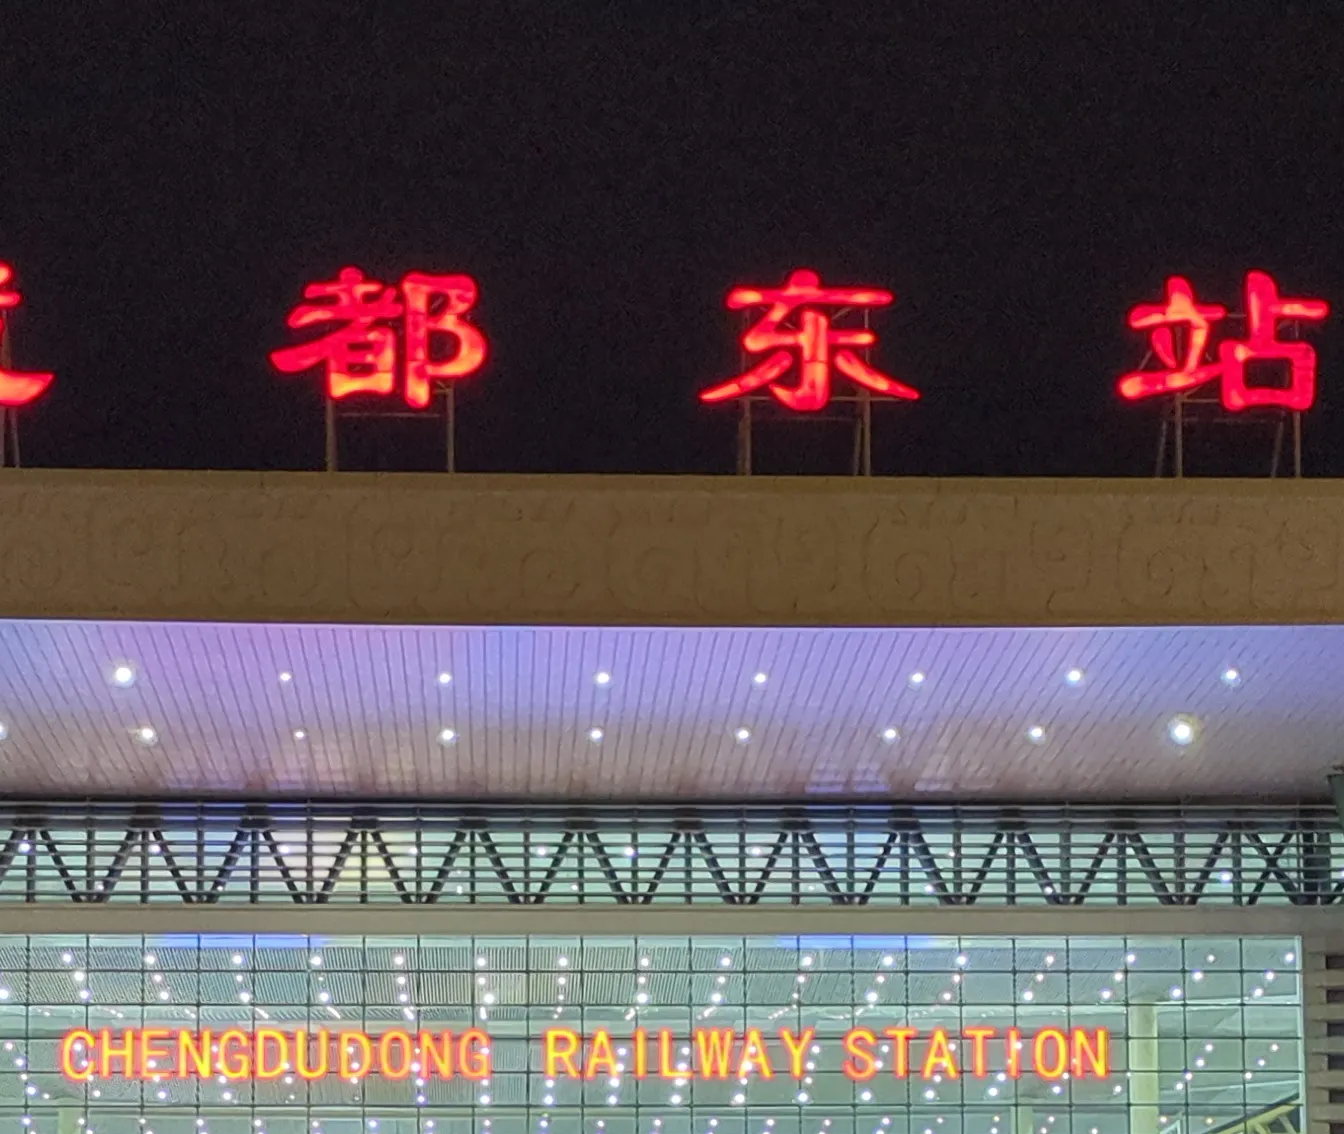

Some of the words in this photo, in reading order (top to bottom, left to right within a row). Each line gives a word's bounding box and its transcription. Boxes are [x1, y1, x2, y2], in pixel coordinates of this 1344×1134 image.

[59, 1028, 492, 1080] CHENGDUDONG
[543, 1028, 814, 1080] RAILWAY
[843, 1027, 1111, 1080] STATION
